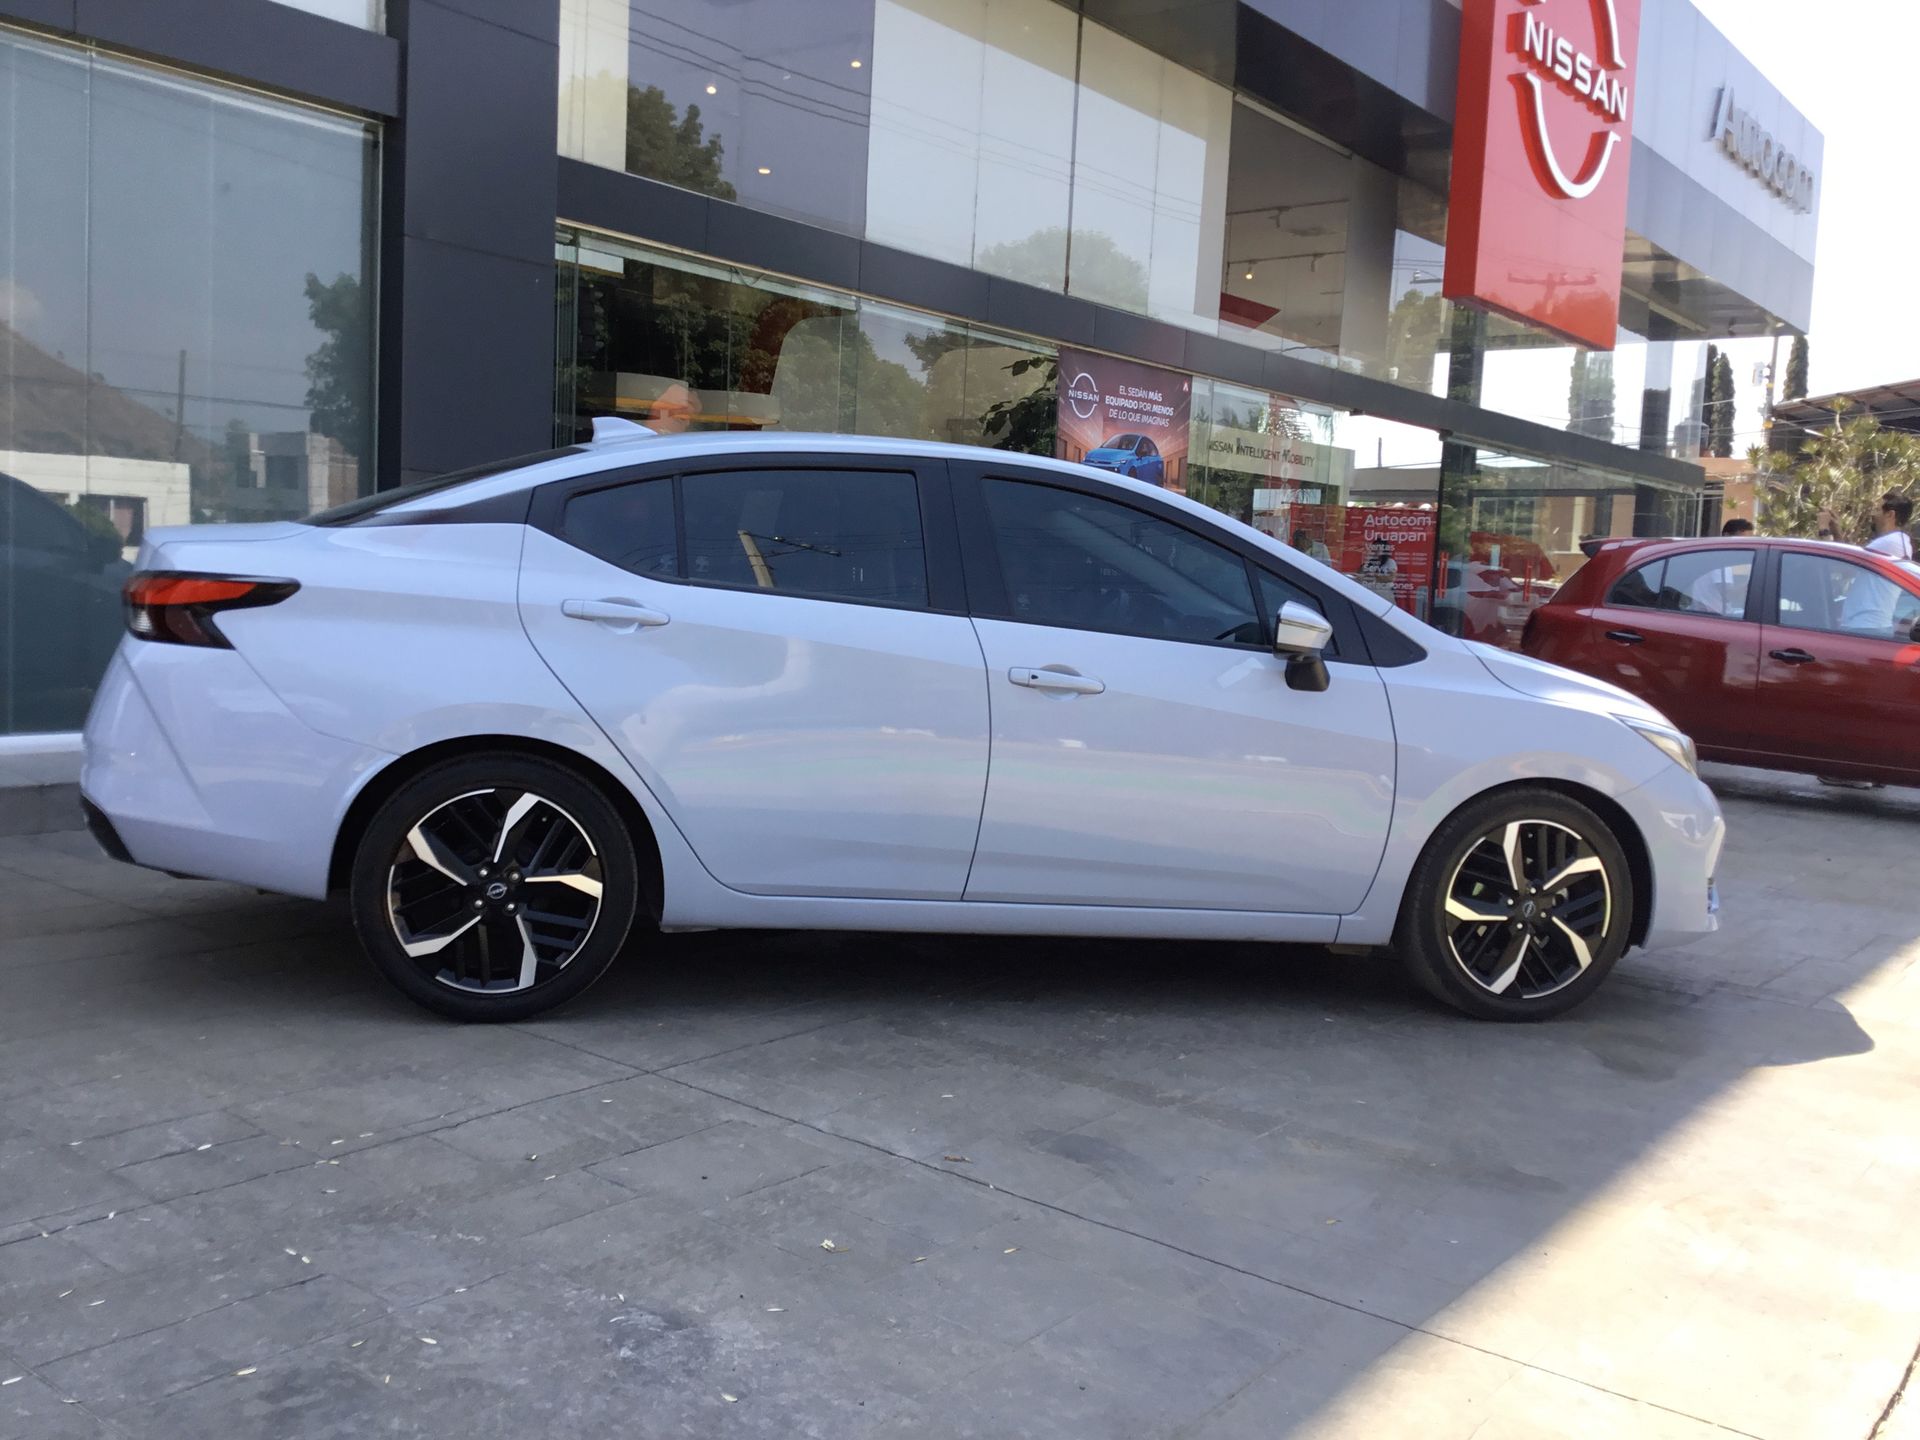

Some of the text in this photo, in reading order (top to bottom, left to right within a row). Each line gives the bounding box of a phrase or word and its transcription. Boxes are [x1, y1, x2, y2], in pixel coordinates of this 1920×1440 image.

[1524, 10, 1628, 122] NISSAN
[1068, 389, 1099, 402] NISSAN
[1119, 385, 1163, 402] EL SEDÁN MÁS
[1105, 395, 1174, 416] EQUIPADO POR MENOS
[1109, 408, 1170, 427] DE LO QUE IMAGINAS
[1364, 514, 1431, 527] Autocom
[1364, 529, 1427, 544] Uruapan
[1365, 543, 1395, 551] Ventas
